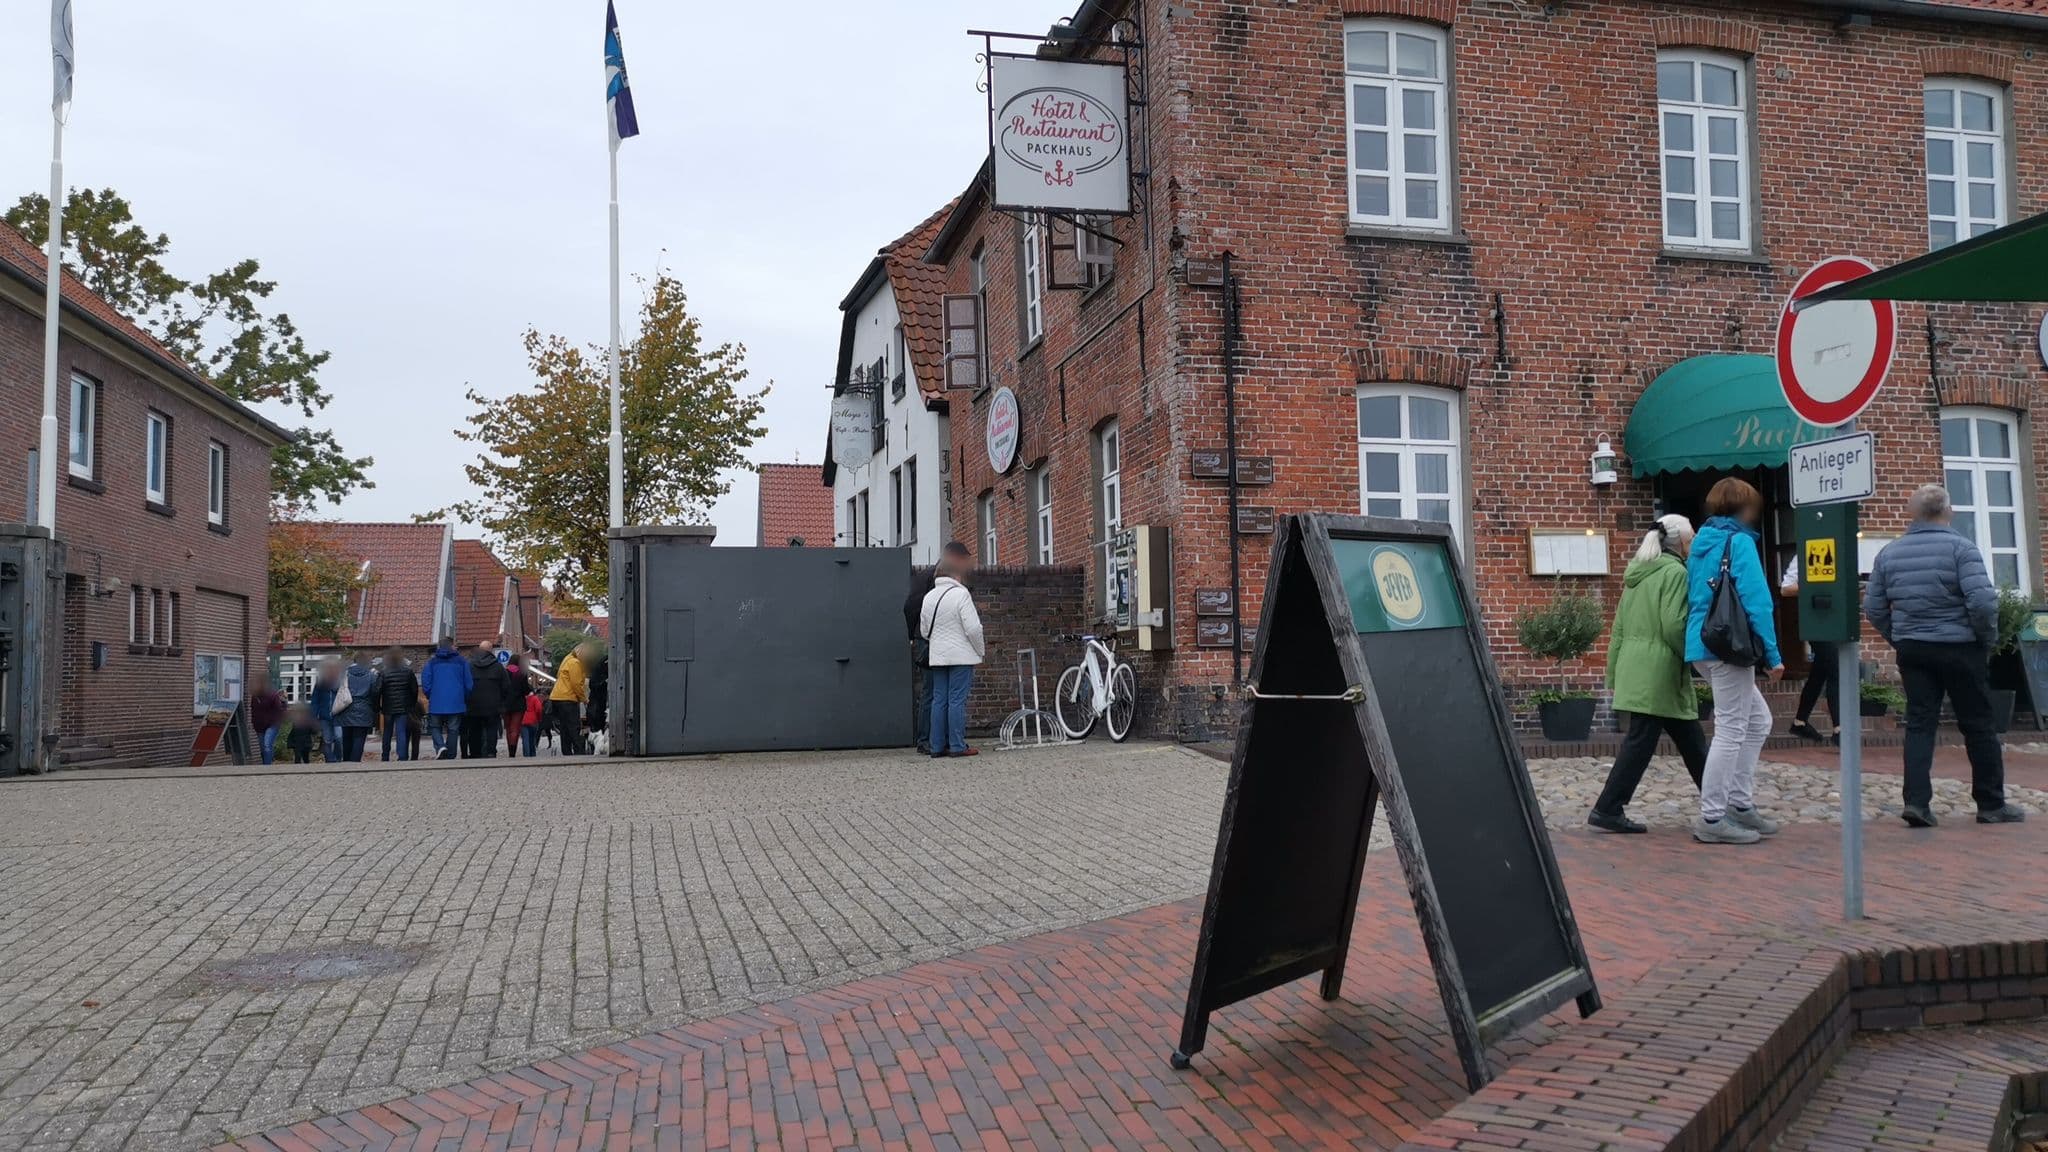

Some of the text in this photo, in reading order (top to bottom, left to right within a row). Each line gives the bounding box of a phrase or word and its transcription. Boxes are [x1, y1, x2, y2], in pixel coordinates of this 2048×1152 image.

[1031, 94, 1091, 123] Hotel &
[1011, 115, 1115, 143] Restaurant
[1027, 143, 1092, 157] PACKHAUS
[1800, 448, 1862, 474] Anlieger
[1818, 473, 1844, 495] frei
[1382, 572, 1414, 602] JEVER
